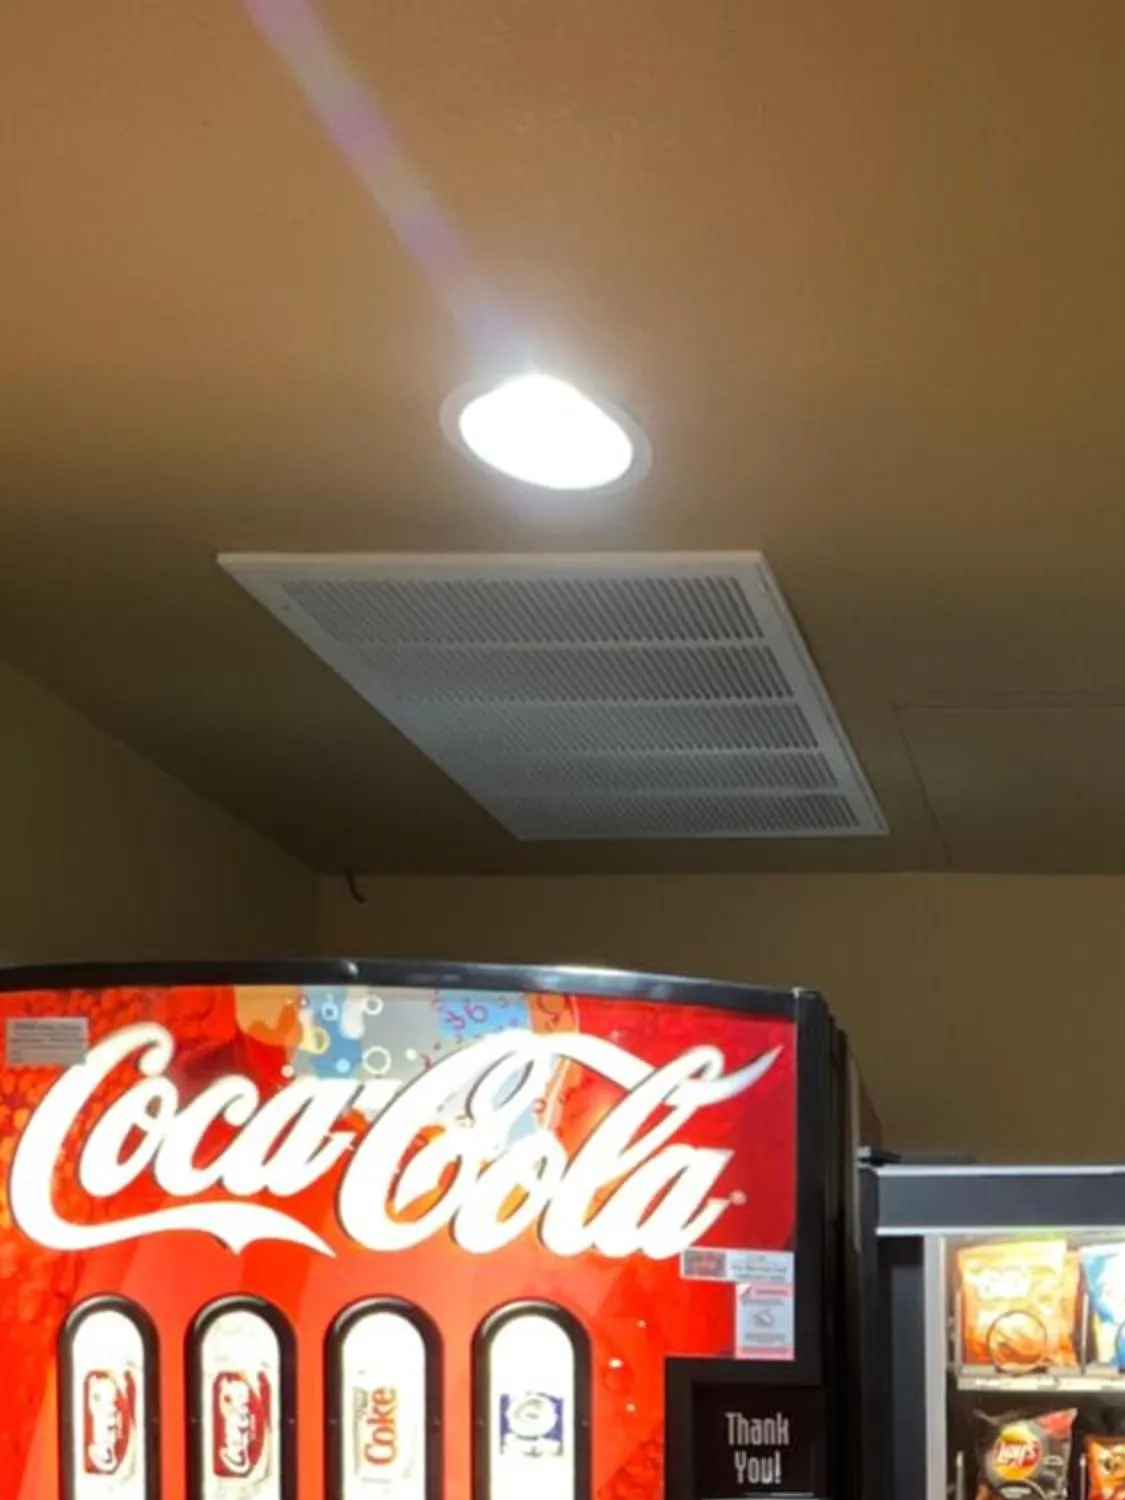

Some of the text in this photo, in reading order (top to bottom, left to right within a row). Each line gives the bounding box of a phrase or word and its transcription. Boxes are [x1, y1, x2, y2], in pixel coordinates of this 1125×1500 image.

[10, 1020, 783, 1259] Coca-Cola
[364, 1385, 398, 1466] Coke
[725, 1412, 790, 1447] Thank
[734, 1450, 782, 1485] You!
